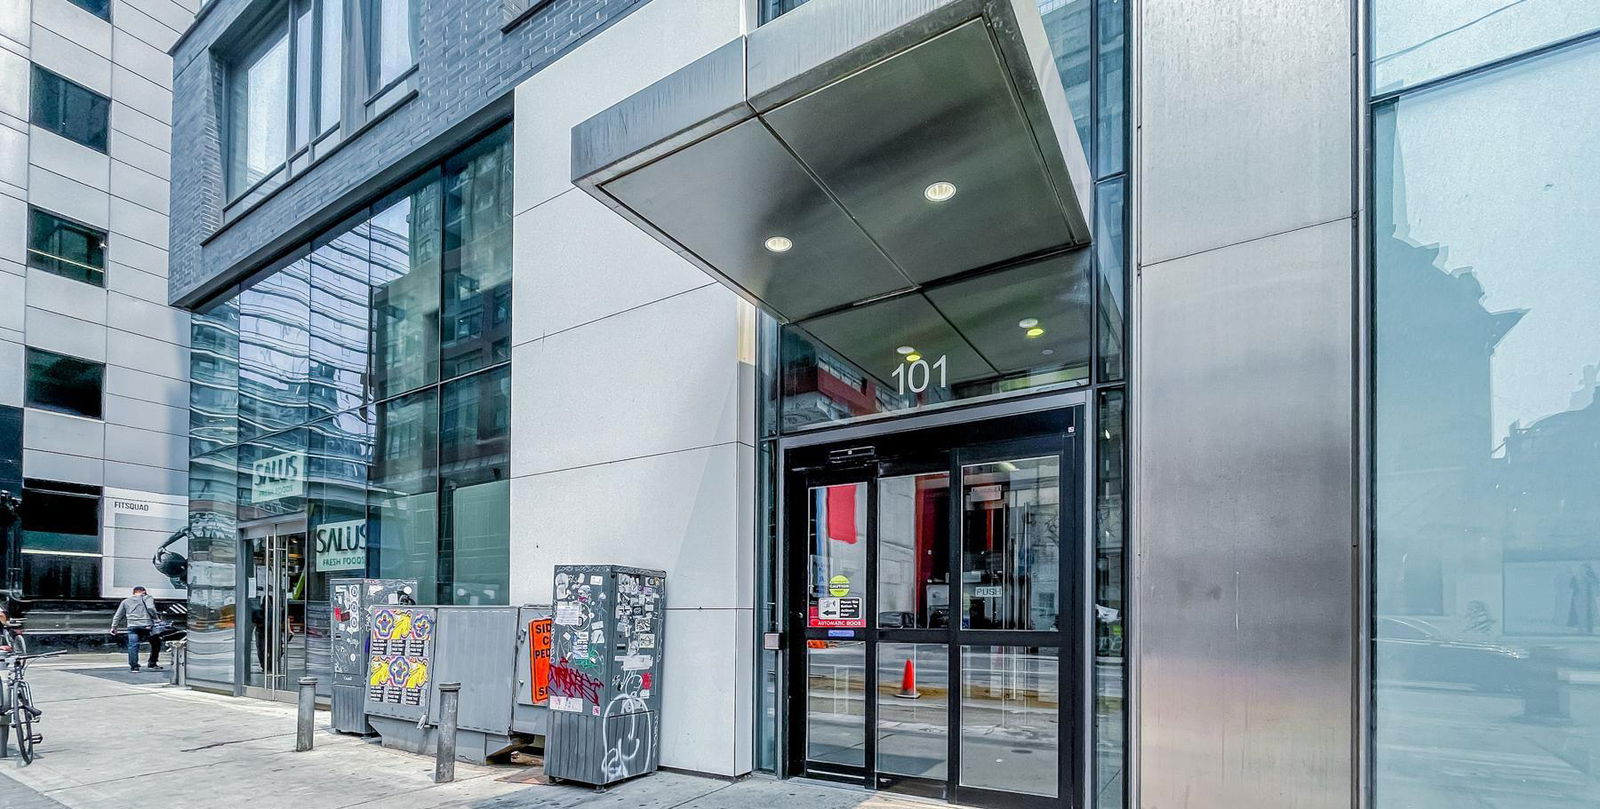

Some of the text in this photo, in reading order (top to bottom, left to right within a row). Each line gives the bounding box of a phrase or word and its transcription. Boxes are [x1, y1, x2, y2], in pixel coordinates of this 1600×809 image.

[891, 355, 947, 395] 101
[254, 455, 298, 486] SALUS
[114, 501, 149, 511] FITSQUAD
[976, 587, 1002, 596] PUSH
